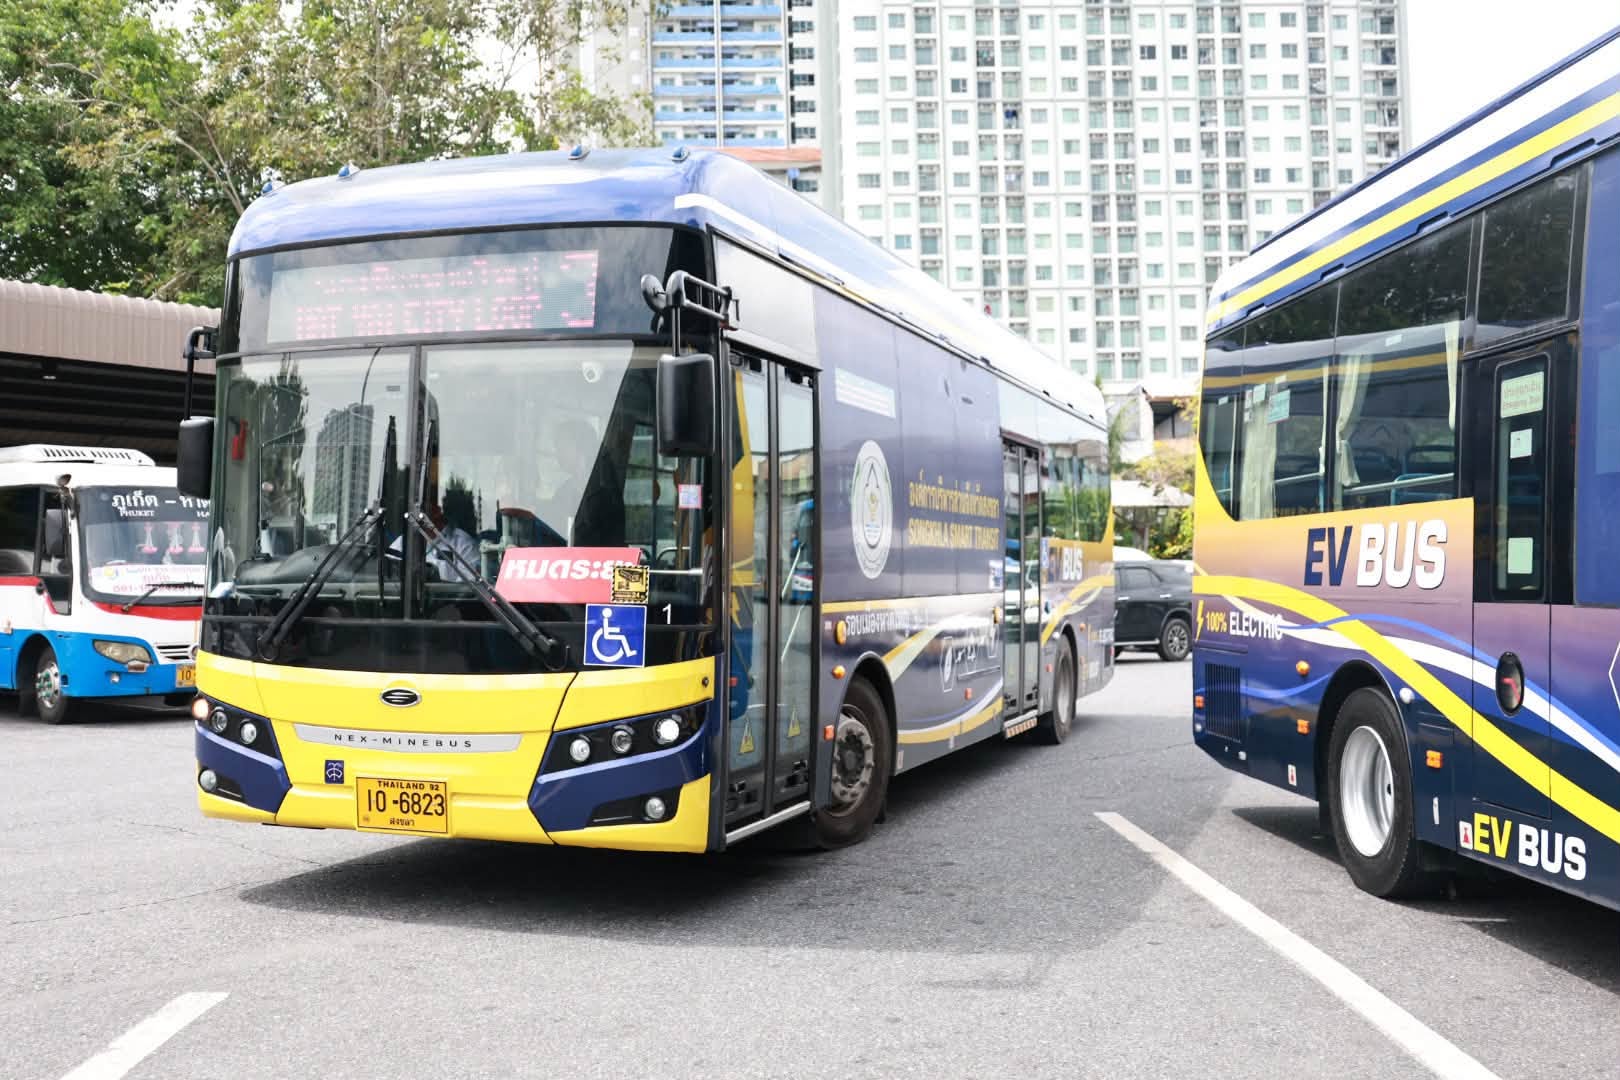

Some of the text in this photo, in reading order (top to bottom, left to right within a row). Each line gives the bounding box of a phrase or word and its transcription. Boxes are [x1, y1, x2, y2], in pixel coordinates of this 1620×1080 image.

[112, 490, 159, 510] ภูเก็ต
[119, 509, 155, 517] PHUKET
[1062, 547, 1083, 580] BUS
[1304, 519, 1448, 590] EV BUS
[662, 603, 671, 624] 1
[1206, 611, 1284, 641] 100% ELECTRIC
[334, 734, 472, 748] NEX-MINEBUS
[377, 780, 425, 790] THAILAND
[1473, 812, 1586, 881] EV BUS
